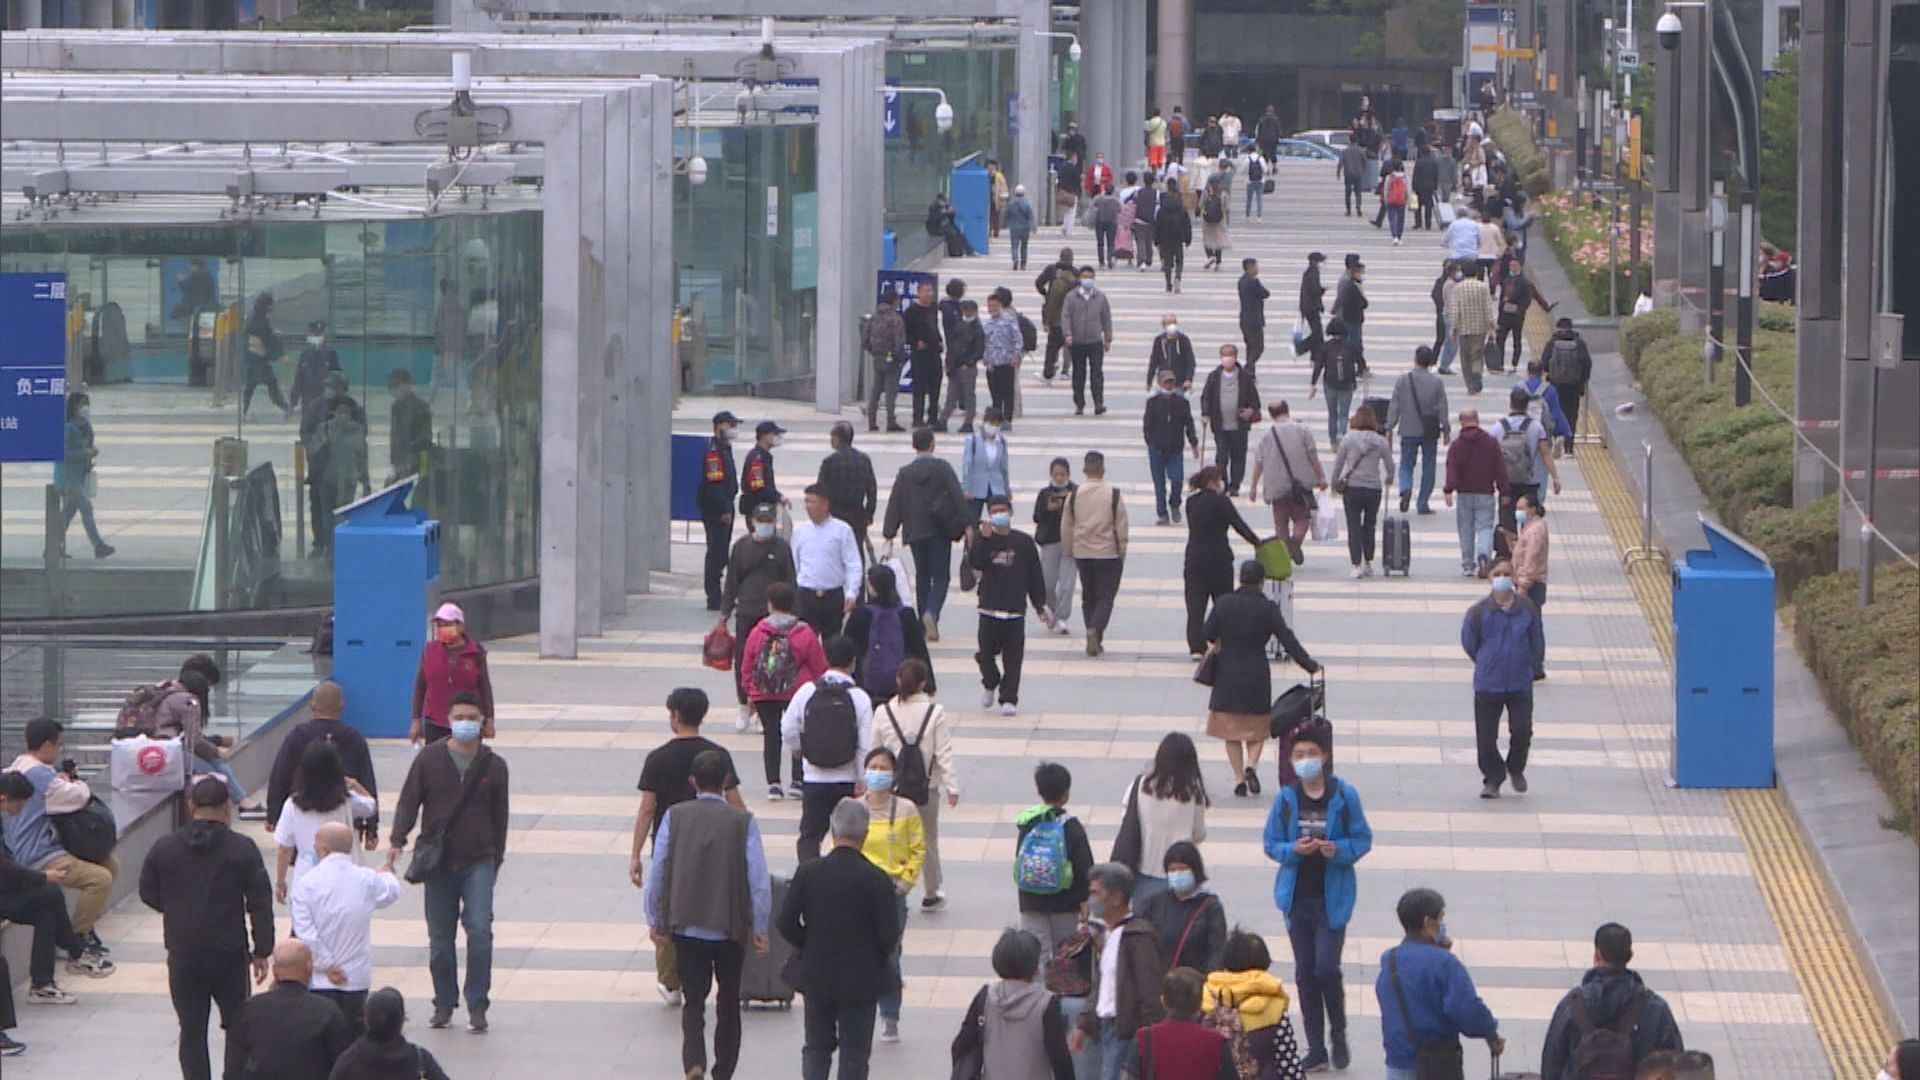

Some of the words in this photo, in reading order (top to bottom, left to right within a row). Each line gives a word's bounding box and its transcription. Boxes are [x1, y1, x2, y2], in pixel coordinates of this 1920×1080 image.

[33, 282, 65, 299] 二层
[17, 378, 65, 395] 负二层
